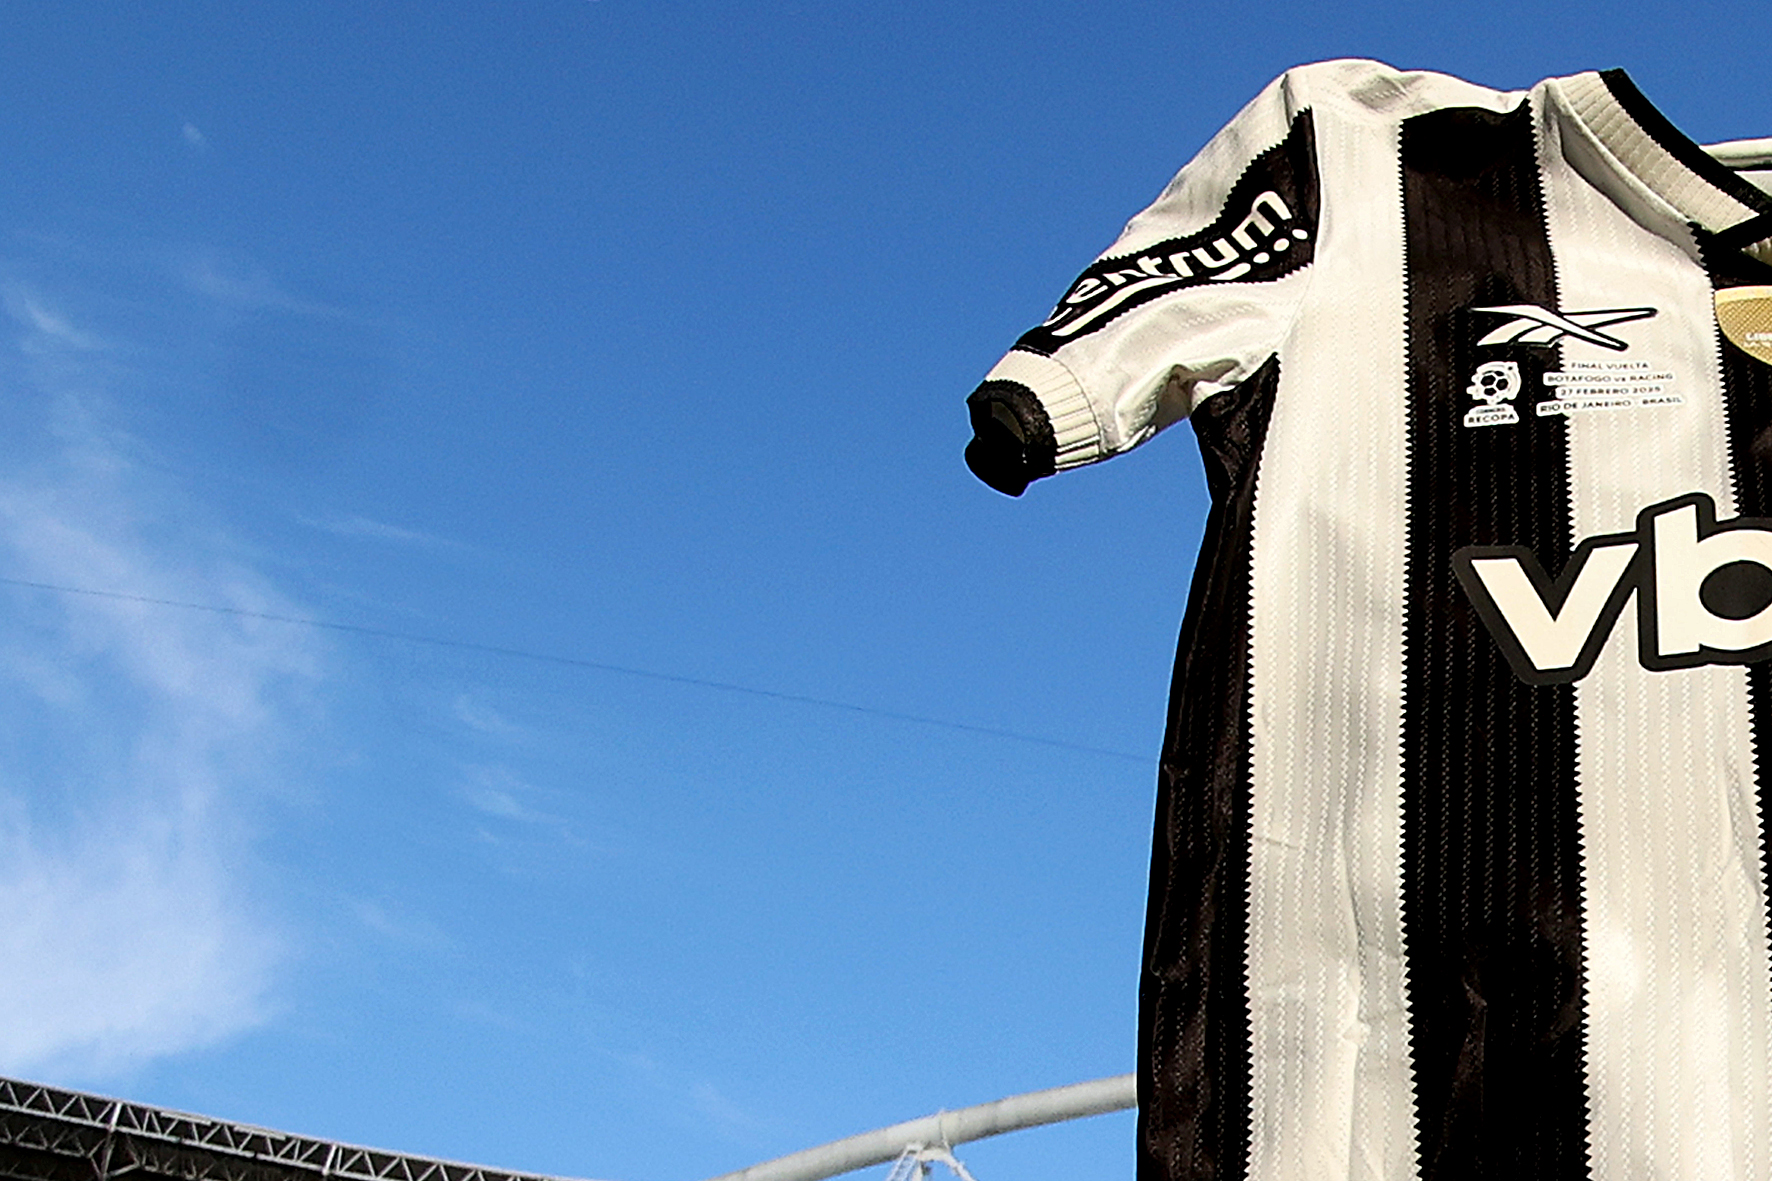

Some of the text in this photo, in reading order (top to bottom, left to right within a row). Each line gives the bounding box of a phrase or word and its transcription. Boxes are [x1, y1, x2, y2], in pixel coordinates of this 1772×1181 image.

[1606, 362, 1649, 370] VUELTA
[1629, 373, 1673, 381] RACING
[1540, 403, 1561, 412] RIO
[1581, 400, 1632, 409] JANEIRO
[1642, 397, 1682, 405] BRASIL
[1468, 414, 1515, 424] RECOPA
